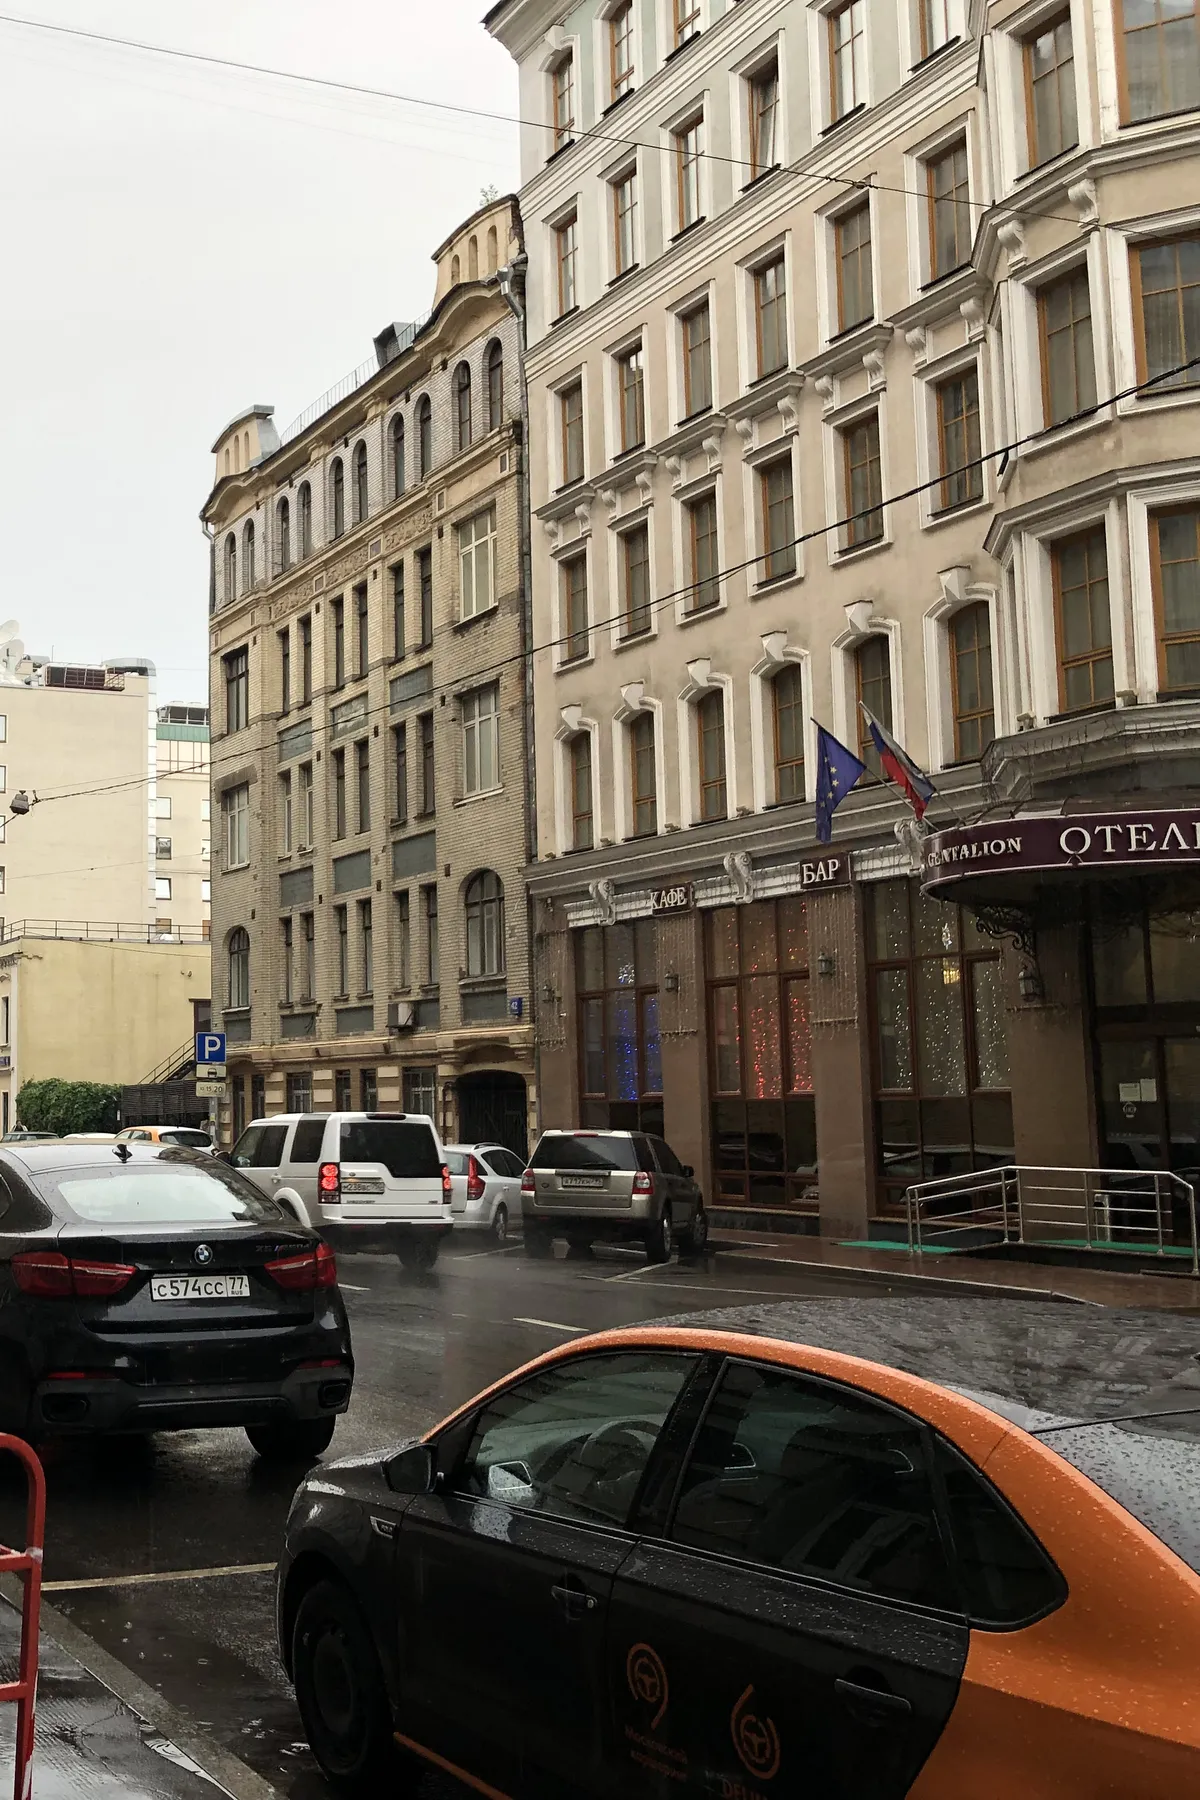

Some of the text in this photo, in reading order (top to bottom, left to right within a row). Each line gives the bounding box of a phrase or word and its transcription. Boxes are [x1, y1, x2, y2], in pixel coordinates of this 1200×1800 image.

[927, 836, 1023, 868] GENTALION
[802, 859, 839, 884] БАР
[649, 886, 688, 910] КАФЕ
[510, 1001, 518, 1010] 42
[204, 1035, 221, 1060] P
[157, 1276, 244, 1297] С574СС 77
